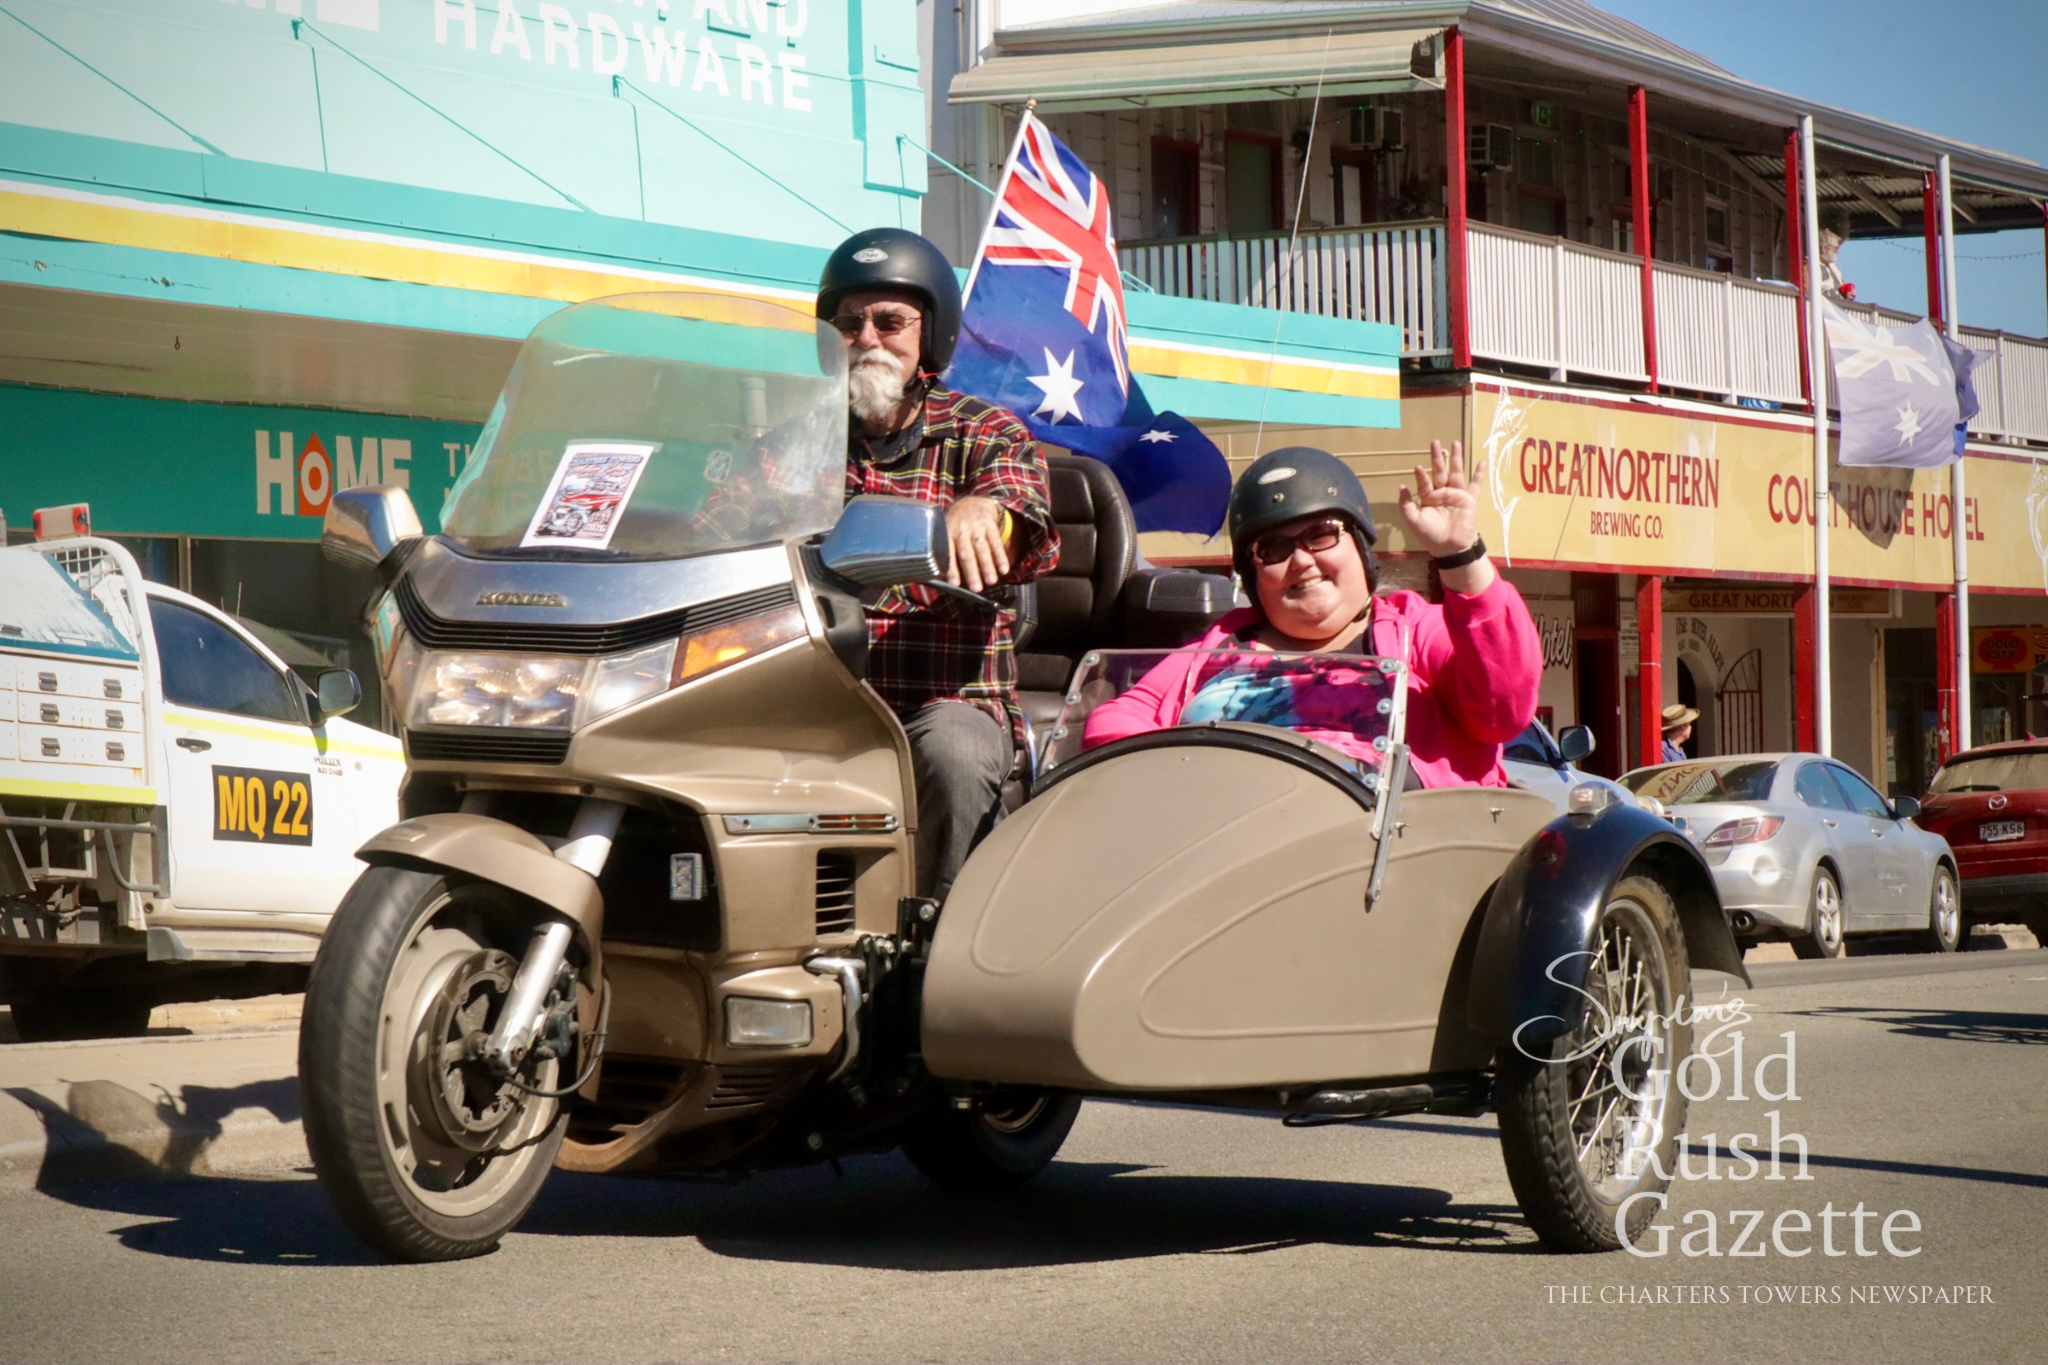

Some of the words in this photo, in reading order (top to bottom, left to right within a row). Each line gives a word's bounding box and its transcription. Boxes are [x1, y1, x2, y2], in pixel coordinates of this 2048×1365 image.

[433, 0, 812, 112] HARDWARE
[1591, 511, 1640, 538] BREWING
[1645, 514, 1664, 539] CO.
[1768, 473, 1841, 529] COUT
[1847, 484, 1915, 536] HOUSE
[1922, 493, 1985, 541] HOEL
[1689, 593, 1740, 609] GREAT
[218, 775, 267, 841] MQ
[273, 780, 308, 836] 22
